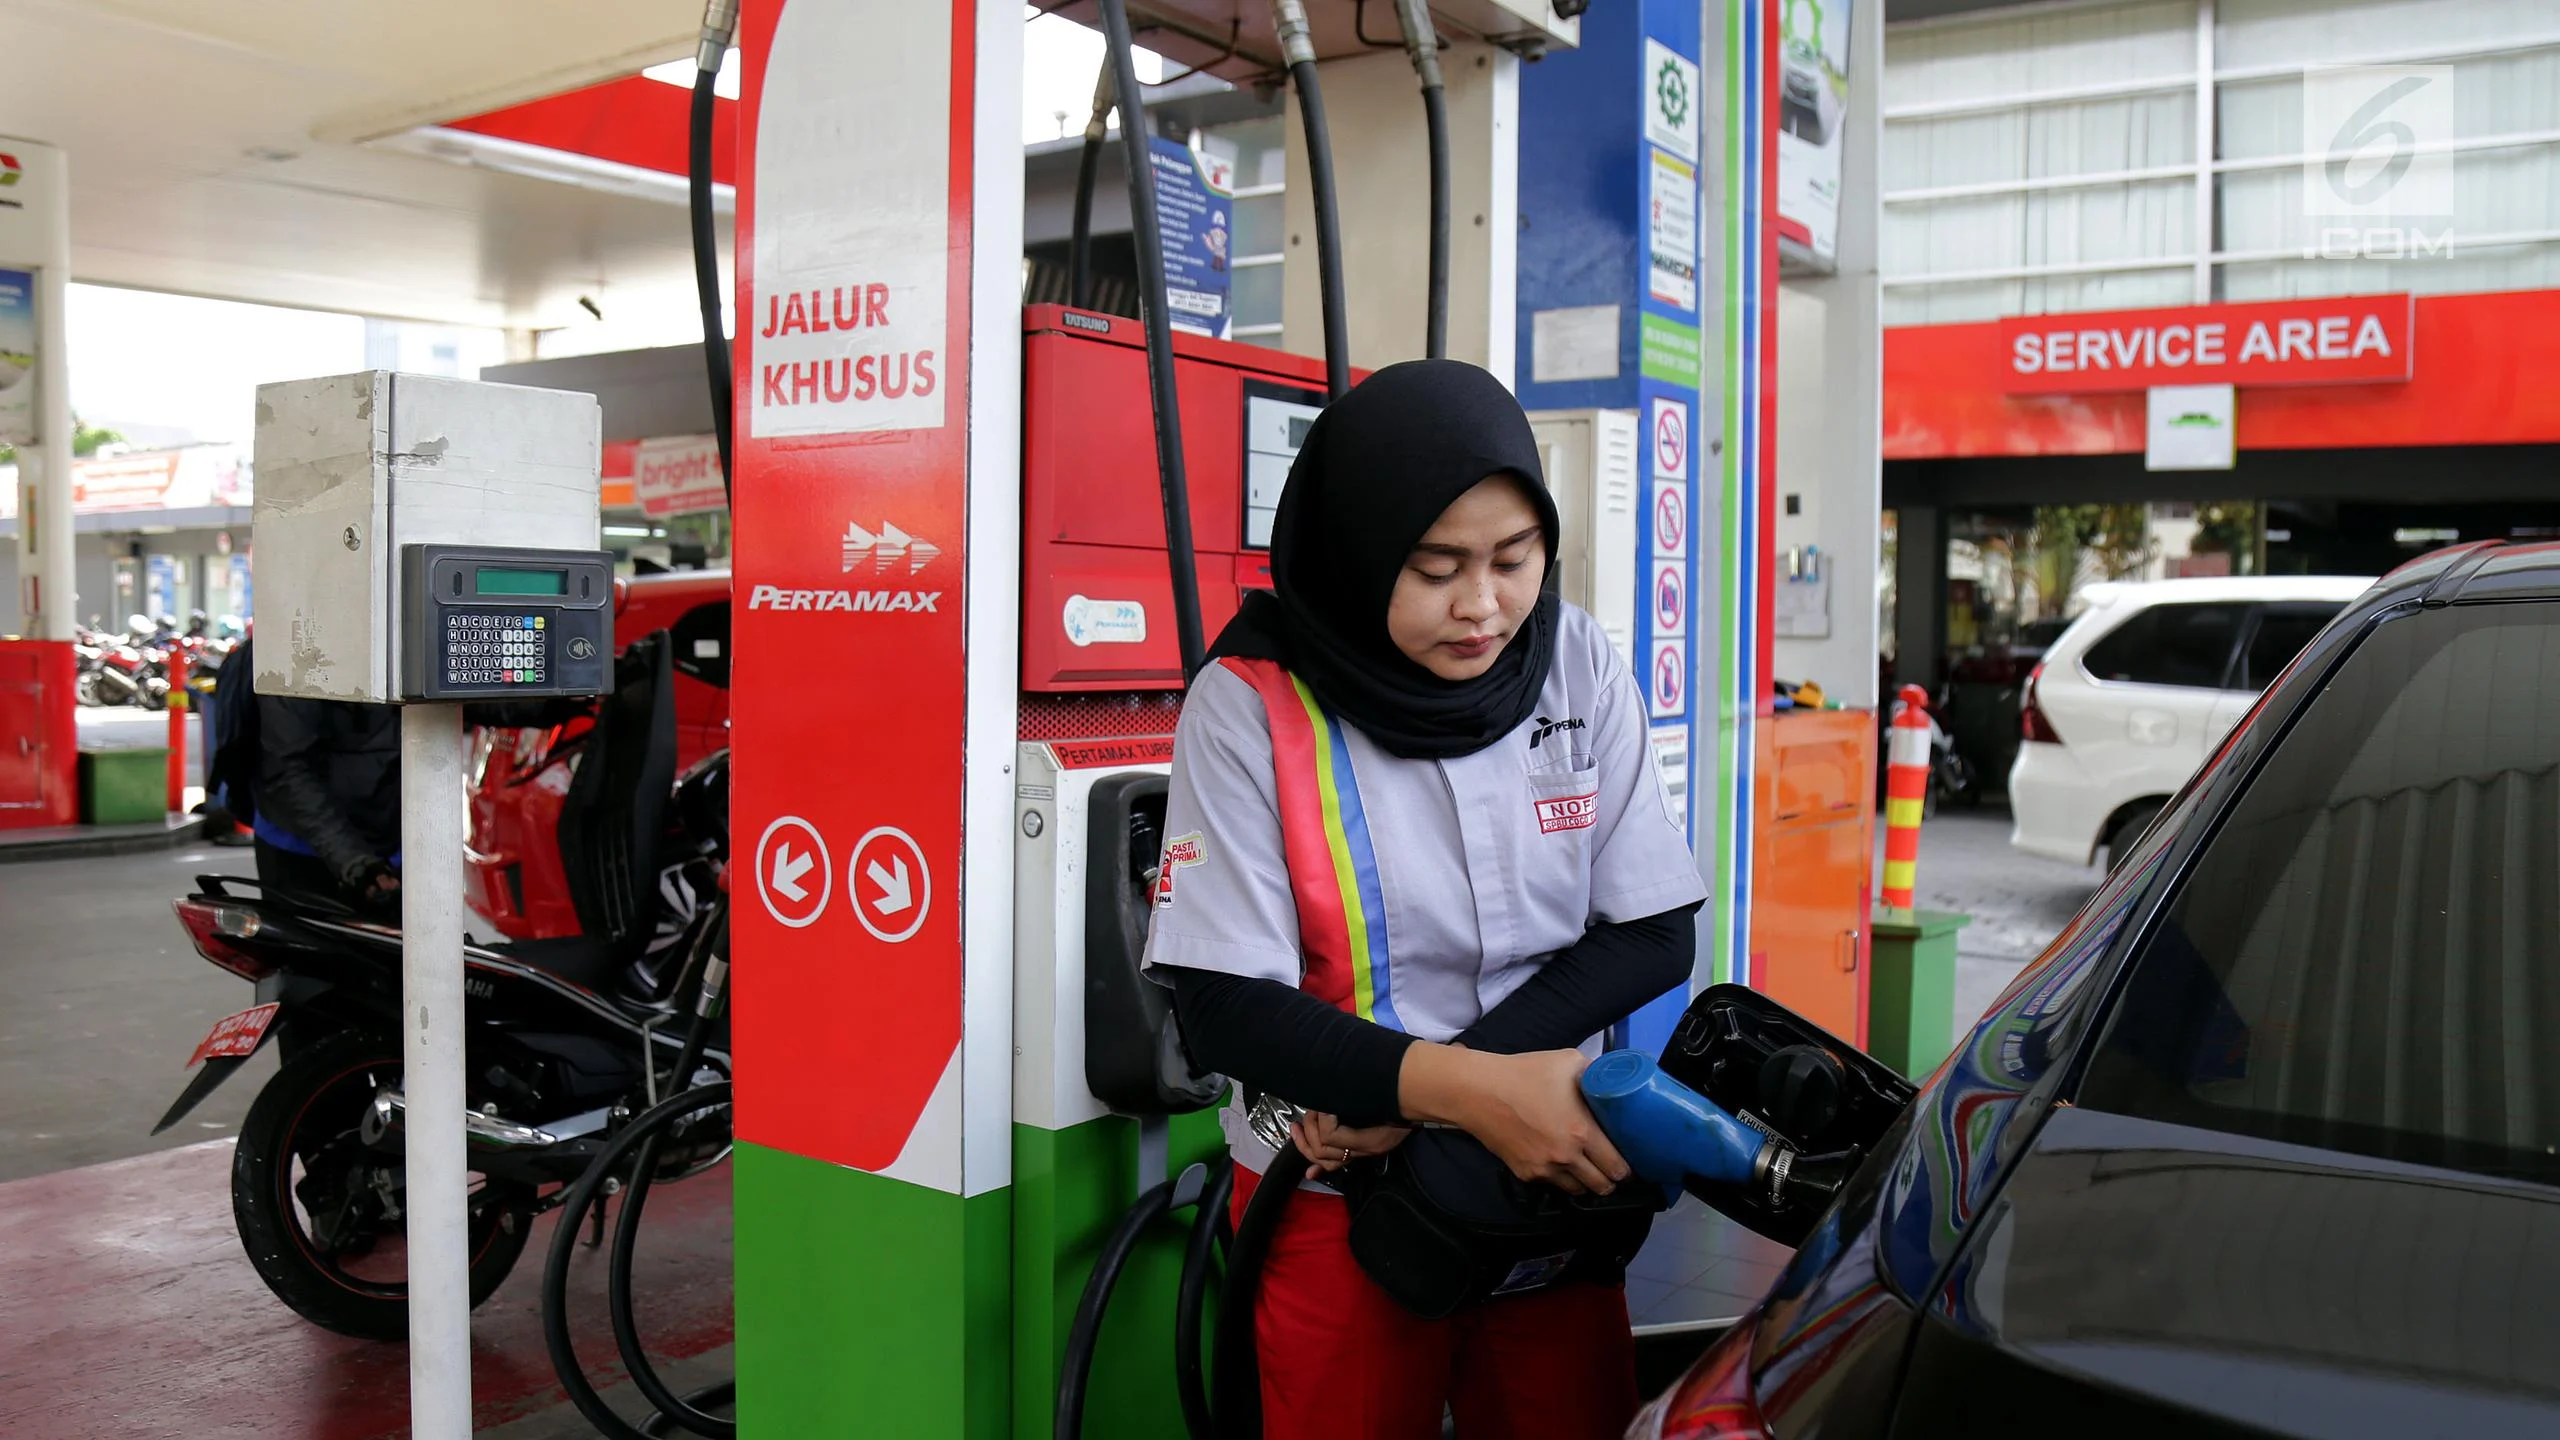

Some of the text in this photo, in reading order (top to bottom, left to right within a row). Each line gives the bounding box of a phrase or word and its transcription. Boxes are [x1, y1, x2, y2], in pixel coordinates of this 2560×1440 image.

[762, 282, 889, 338] JALUR
[2012, 314, 2392, 373] SERVICE AREA
[762, 349, 936, 408] KHUSUS
[747, 584, 942, 613] PERTAMAX
[1057, 741, 1174, 765] PERTAMAX TURB
[1172, 840, 1194, 853] PASTI
